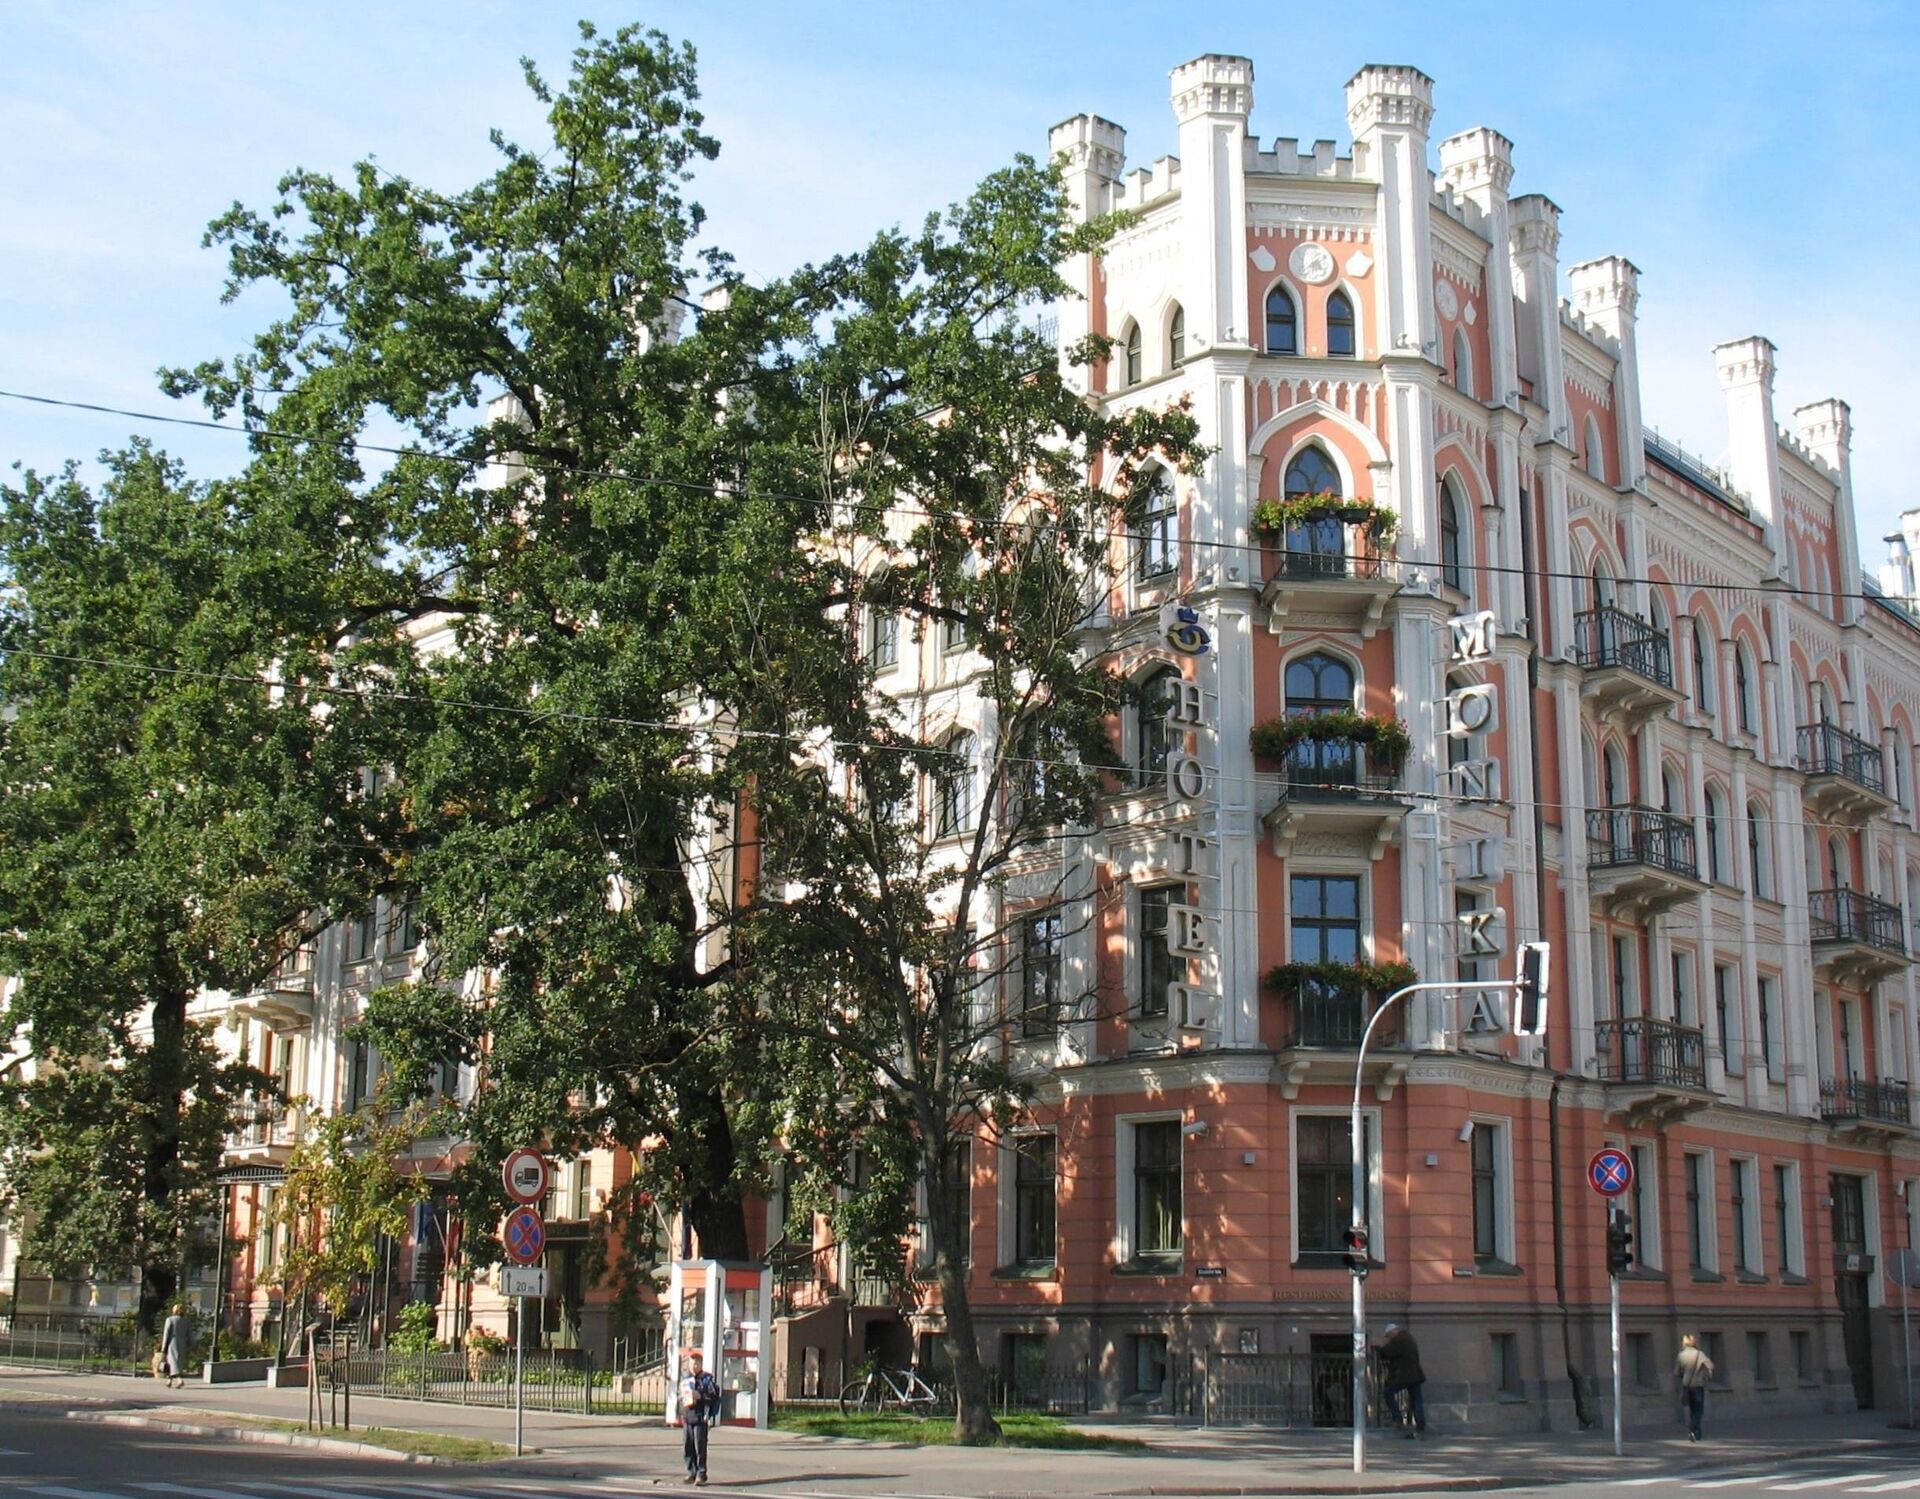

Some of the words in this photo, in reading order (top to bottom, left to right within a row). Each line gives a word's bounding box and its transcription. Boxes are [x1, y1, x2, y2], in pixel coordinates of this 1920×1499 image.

[1172, 682, 1208, 1030] HOTEL
[1449, 612, 1502, 1032] MONIKA
[515, 1281, 527, 1292] 20
